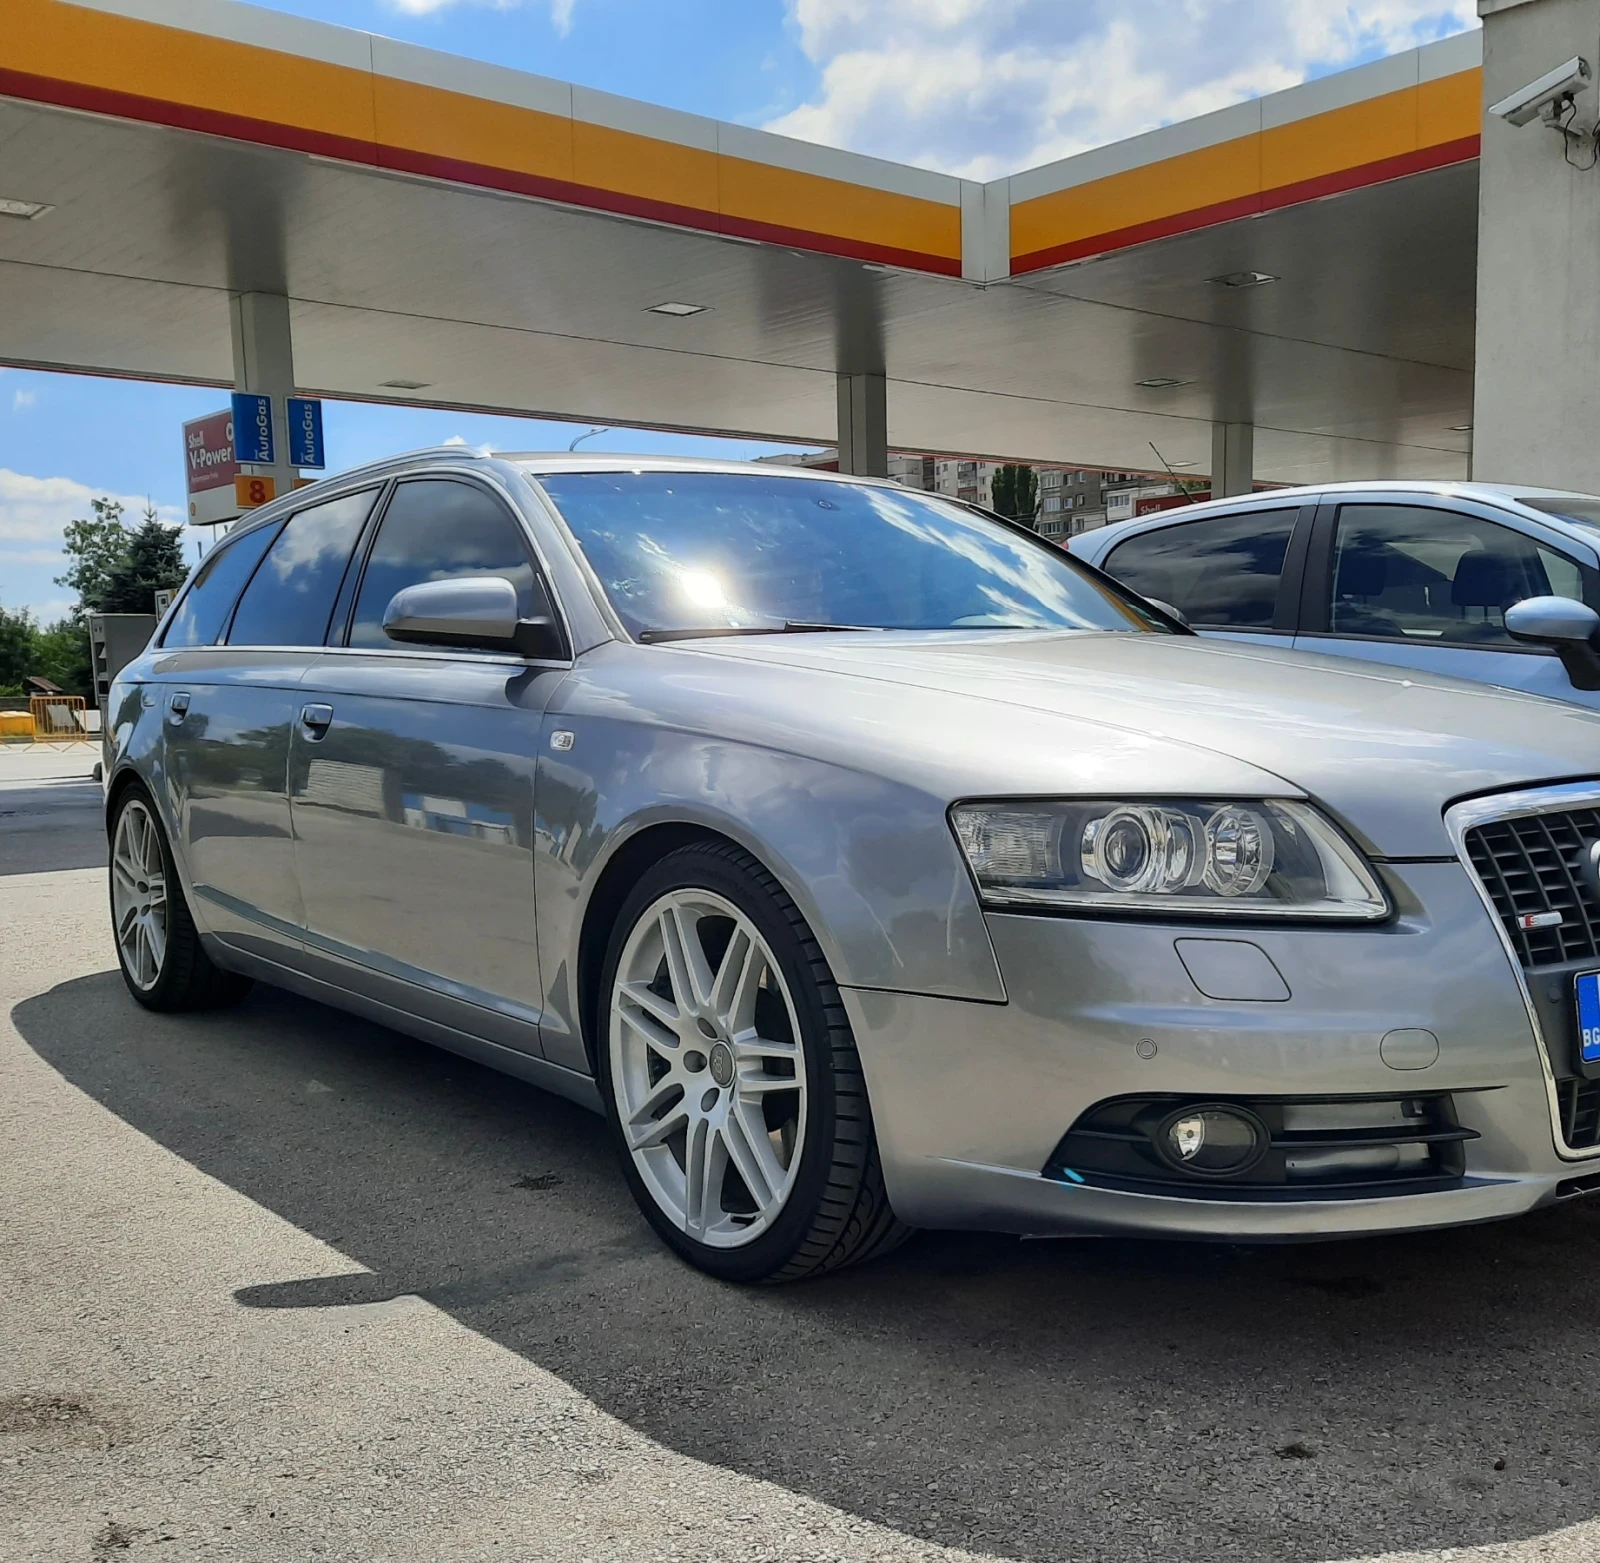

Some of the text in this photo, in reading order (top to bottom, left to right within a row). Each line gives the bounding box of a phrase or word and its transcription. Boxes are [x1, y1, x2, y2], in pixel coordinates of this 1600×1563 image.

[188, 430, 204, 449] Shell
[256, 398, 270, 461] AutoGas
[303, 403, 315, 464] AutoGas
[189, 446, 232, 470] V-Power
[250, 480, 266, 503] 8
[1583, 1027, 1600, 1047] BG
